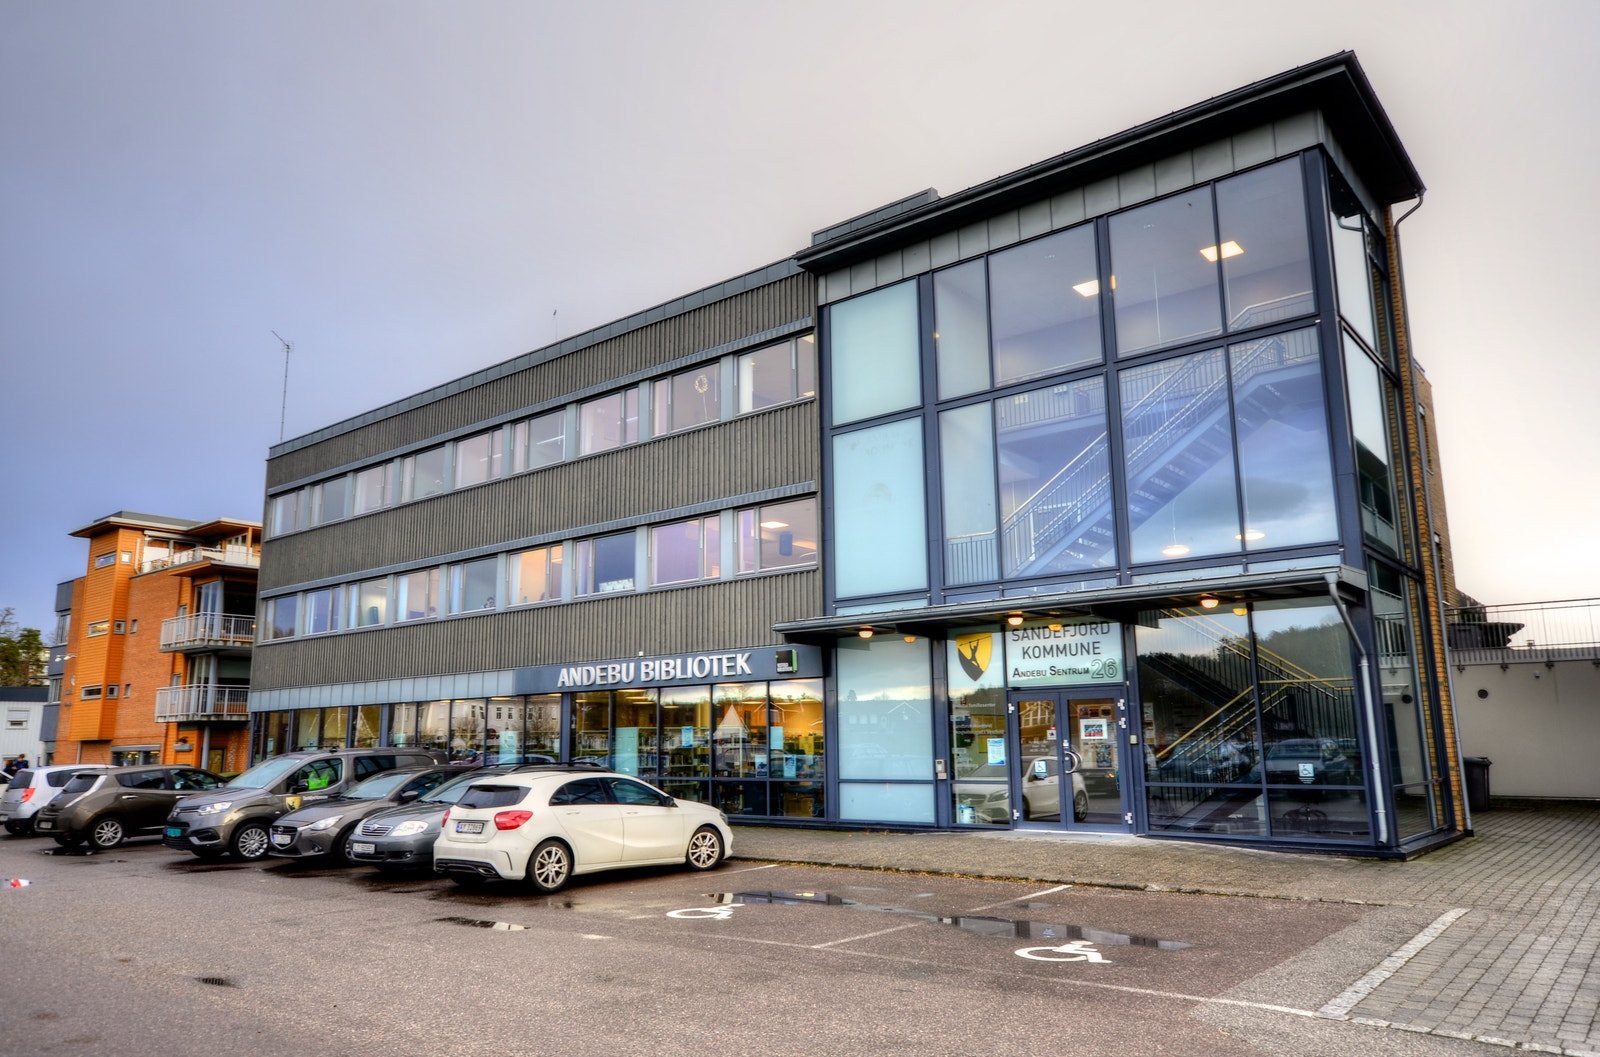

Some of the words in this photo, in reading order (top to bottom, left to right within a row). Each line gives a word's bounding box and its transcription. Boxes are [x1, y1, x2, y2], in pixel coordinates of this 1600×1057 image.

[1011, 621, 1110, 642] SANDEFJORD
[1022, 641, 1101, 659] KOMMUNE
[557, 662, 635, 688] ANDEBU
[640, 652, 752, 682] BIBLIOTEK
[1091, 658, 1118, 679] 26
